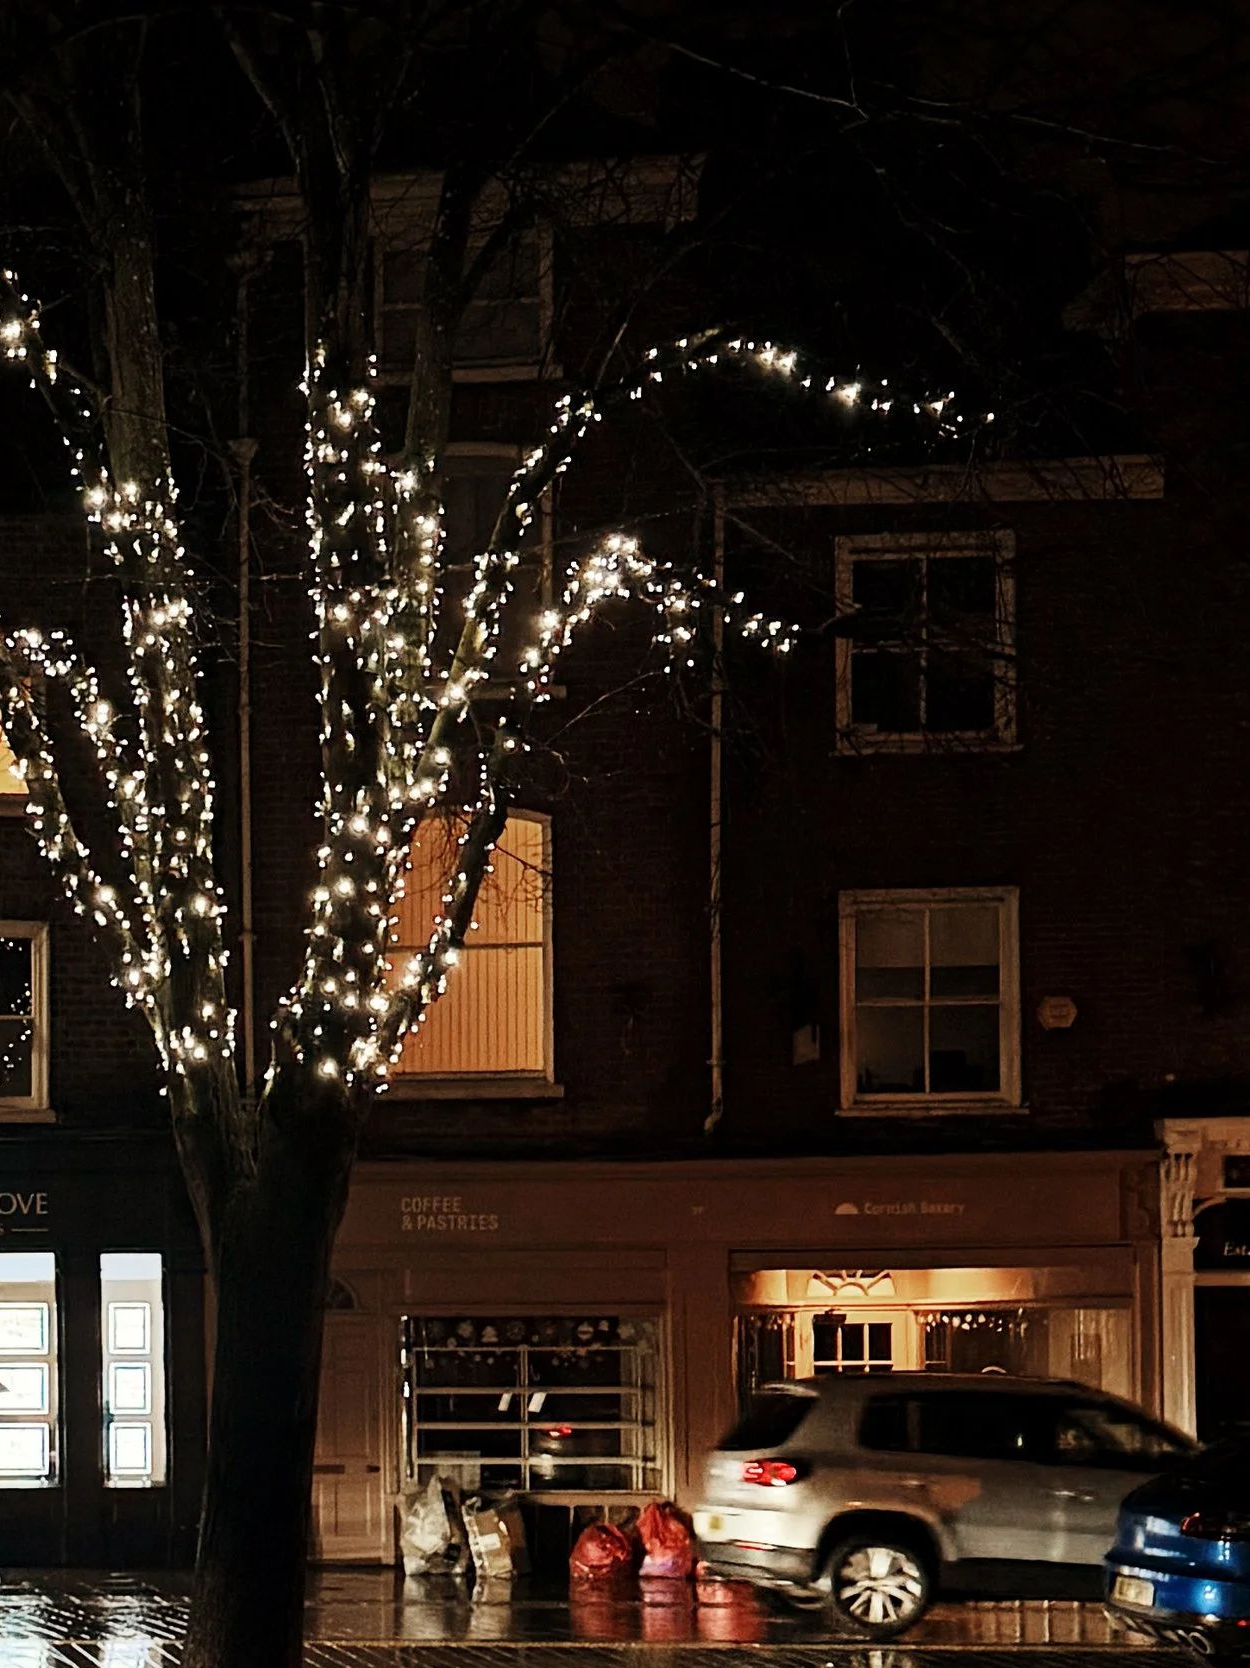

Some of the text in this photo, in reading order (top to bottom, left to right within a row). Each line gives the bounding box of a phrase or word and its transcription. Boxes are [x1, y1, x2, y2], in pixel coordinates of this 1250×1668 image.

[401, 1196, 463, 1213] COFFEE
[401, 1214, 499, 1231] & PASTRIES
